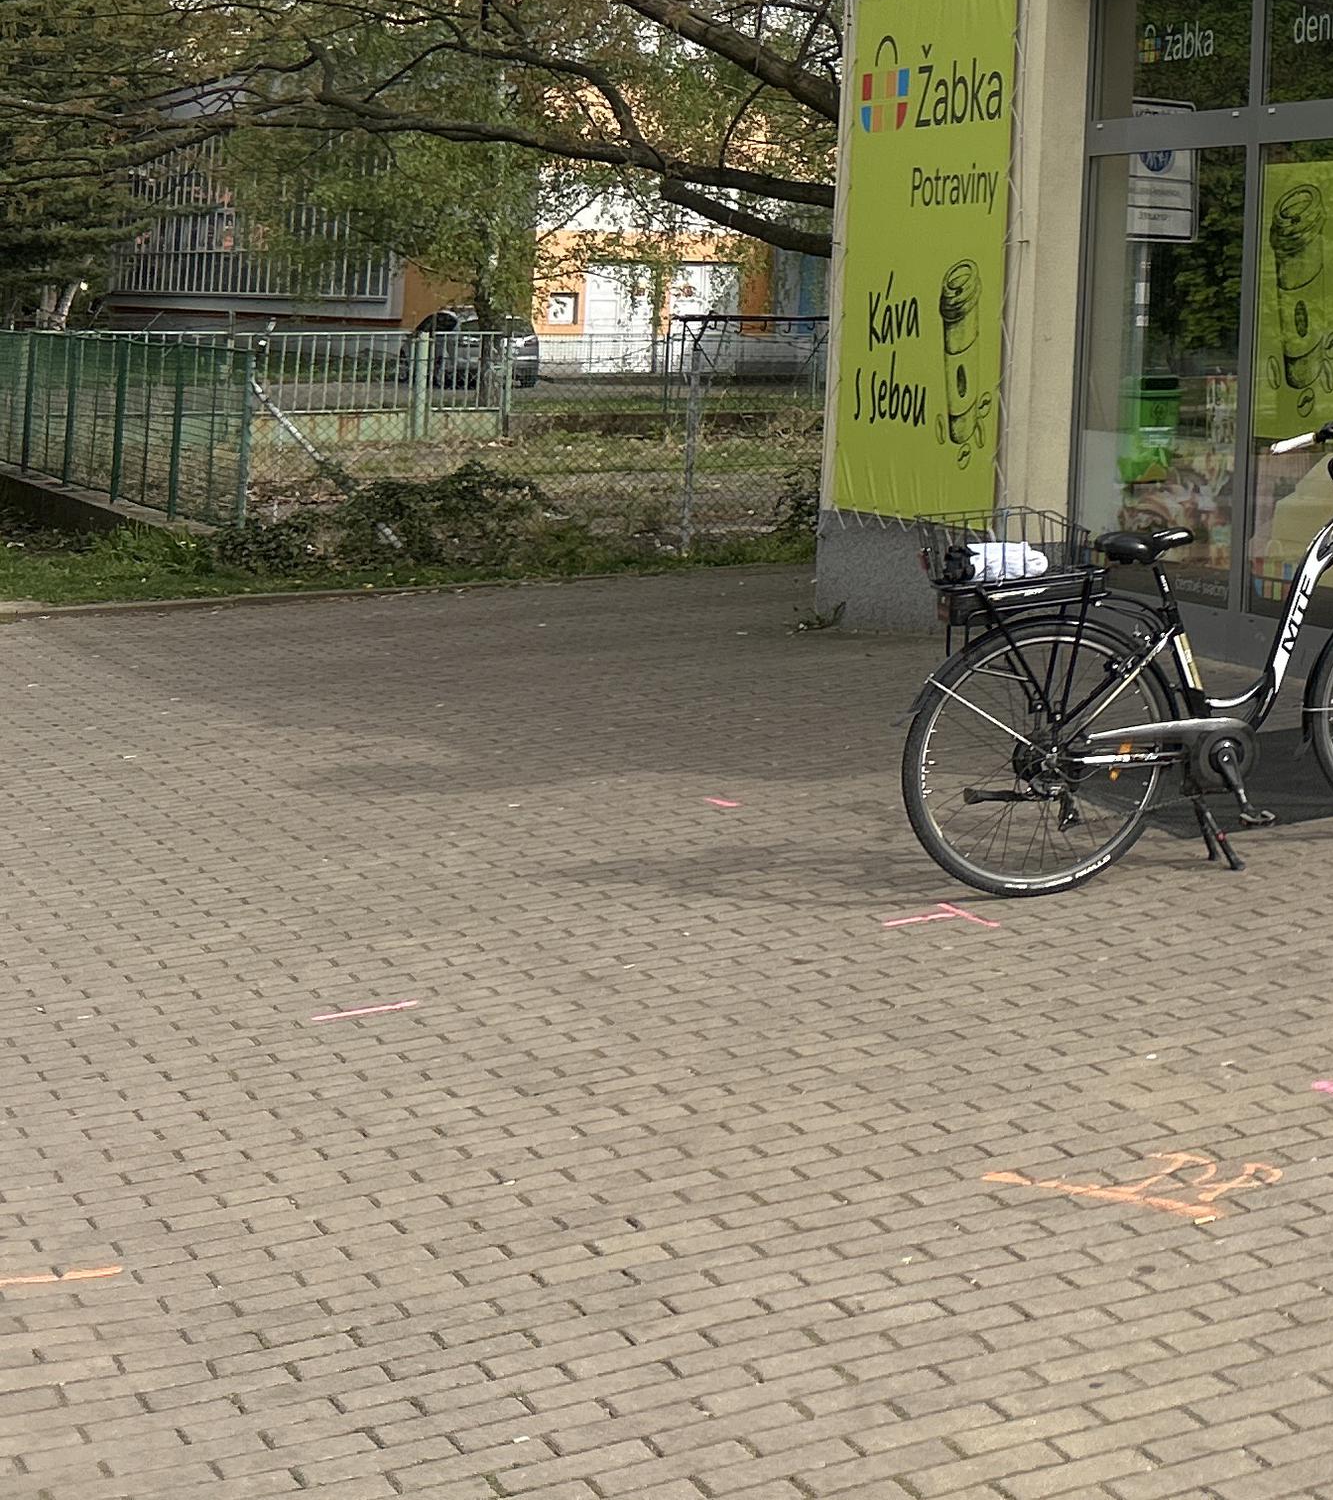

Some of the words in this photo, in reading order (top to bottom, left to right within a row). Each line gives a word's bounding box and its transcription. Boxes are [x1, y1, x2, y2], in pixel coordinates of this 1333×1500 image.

[1163, 21, 1215, 62] žabka
[915, 43, 1003, 128] Žabka
[910, 162, 999, 215] Potraviny
[868, 270, 920, 351] Káva
